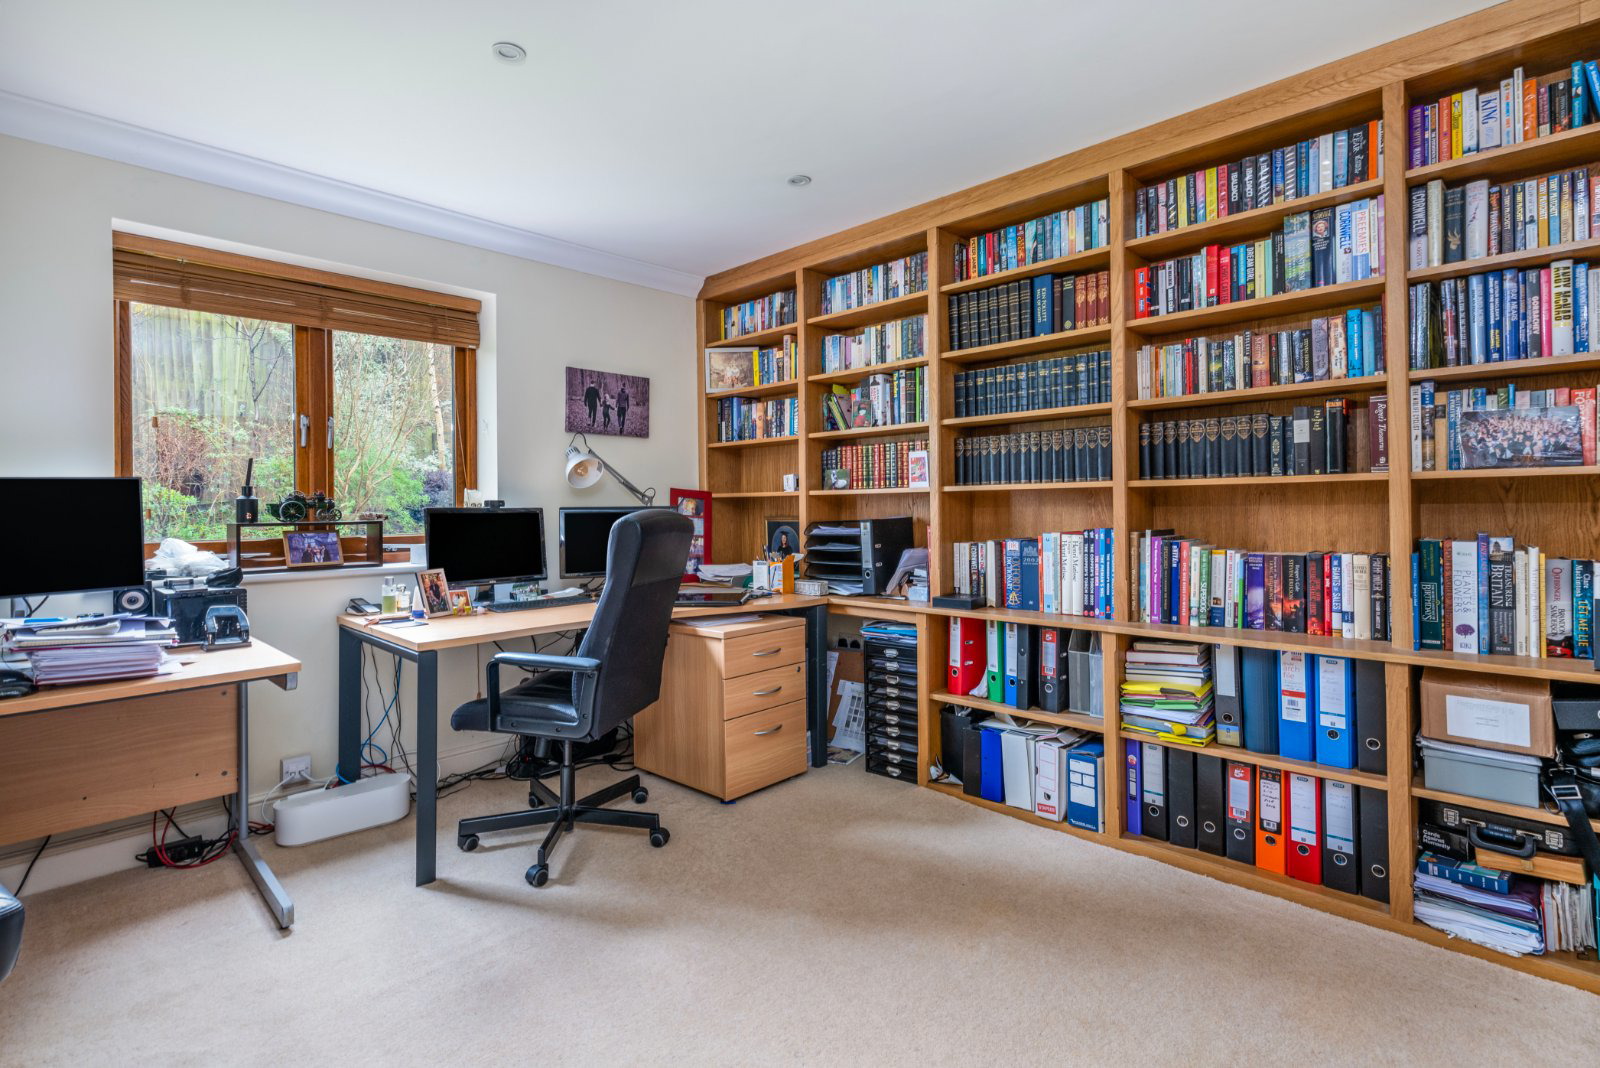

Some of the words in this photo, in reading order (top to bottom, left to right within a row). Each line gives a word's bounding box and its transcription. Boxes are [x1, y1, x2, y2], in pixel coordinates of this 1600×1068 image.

[1481, 97, 1498, 124] KING
[1340, 210, 1351, 249] CORNWELL
[1412, 194, 1425, 232] CORNWELL
[1358, 212, 1366, 253] PREEMIES
[1562, 266, 1571, 288] ANDY
[1532, 296, 1540, 334] GORBACHEV
[1375, 403, 1386, 422] Roget's
[1378, 424, 1387, 450] Thesaurus
[1012, 557, 1020, 591] OXFORD
[1373, 558, 1382, 591] PATHFINDER
[1463, 570, 1471, 605] PLANTS
[1491, 564, 1503, 607] BRITAIN
[1504, 565, 1512, 601] TREASURES
[1422, 584, 1432, 620] BIRTHDAYS
[1454, 570, 1462, 613] FLOWERS
[1578, 600, 1588, 616] LET
[1578, 618, 1588, 630] ME
[1578, 635, 1588, 646] LIE
[1423, 830, 1440, 839] Cards
[1423, 835, 1444, 844] Against
[1423, 839, 1450, 850] Humanity
